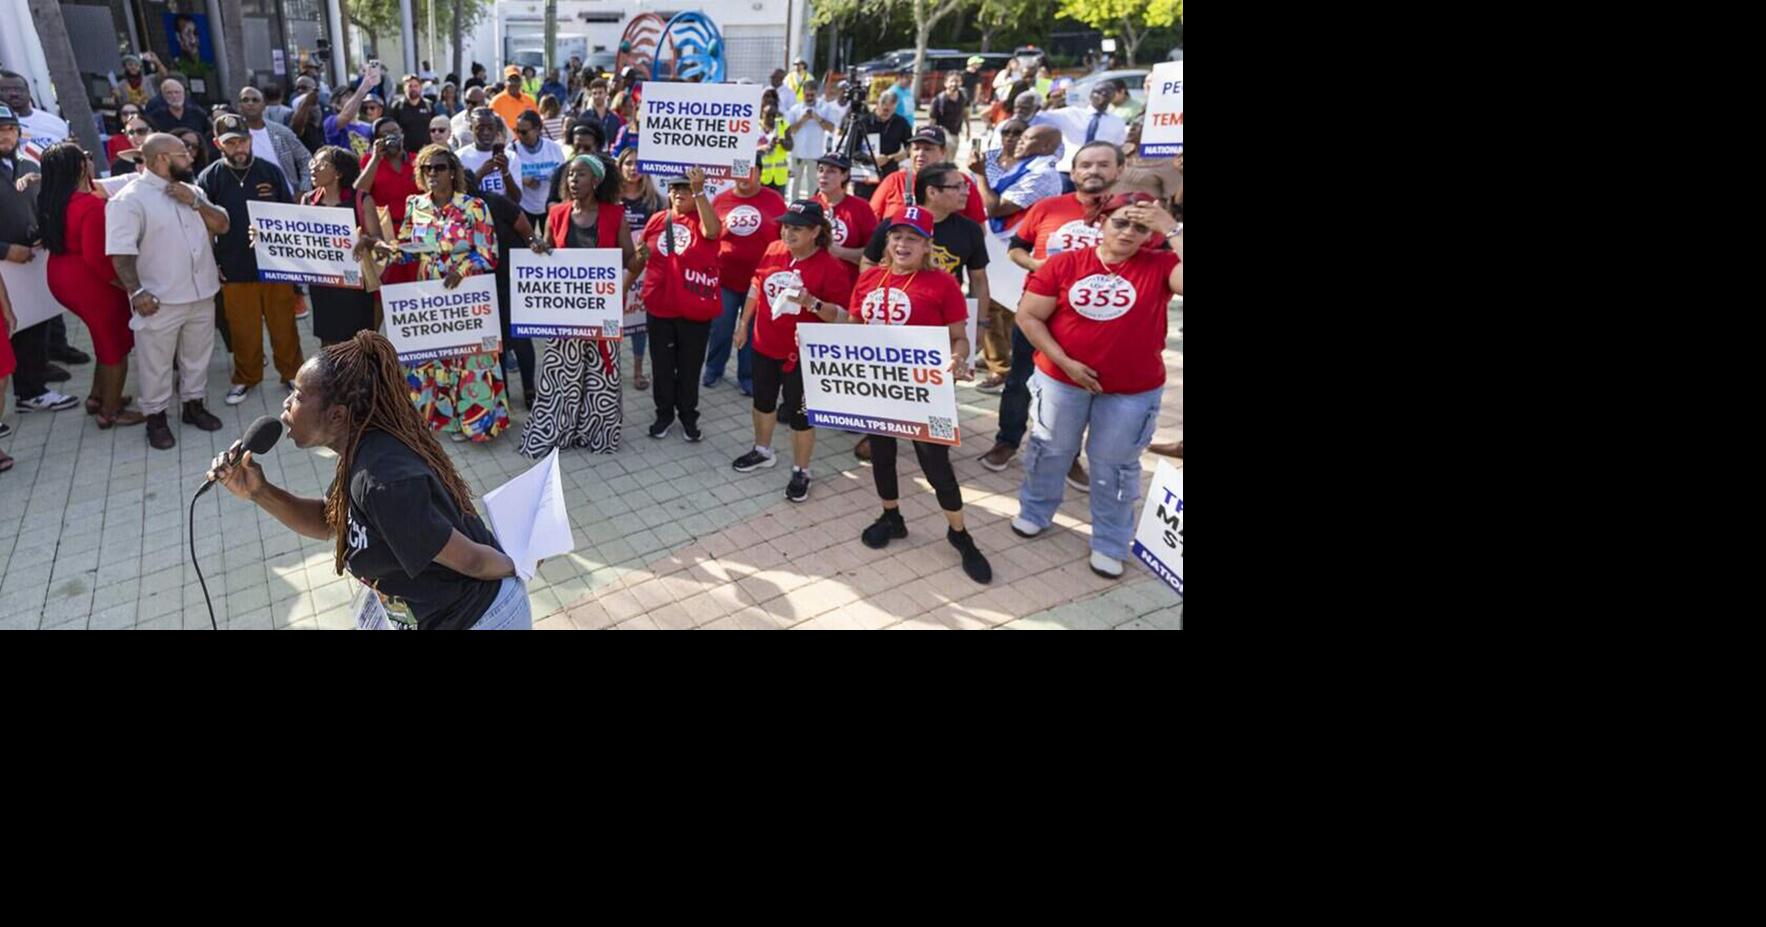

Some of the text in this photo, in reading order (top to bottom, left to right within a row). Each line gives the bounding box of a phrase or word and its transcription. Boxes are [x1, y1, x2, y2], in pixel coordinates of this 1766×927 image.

[1162, 81, 1183, 94] PE
[647, 101, 753, 117] TPS HOLDERS
[647, 117, 751, 133] MAKE THE US
[652, 132, 738, 149] STRONGER
[642, 163, 684, 173] NATIONAL
[256, 217, 351, 236] TPS HOLDERS
[730, 215, 758, 228] 355
[260, 232, 352, 249] MAKE THE US
[268, 245, 344, 262] STRONGER
[265, 272, 340, 284] NATIONAL TPS RALLY
[516, 266, 616, 279] TPS HOLDERS
[517, 281, 616, 295] MAKE THE US
[389, 291, 491, 313] TPS HOLDERS
[524, 296, 606, 310] STRONGER
[1074, 288, 1130, 307] 355
[392, 304, 492, 326] MAKE THE US
[401, 318, 483, 338] STRONGER
[516, 326, 598, 336] NATIONAL TPS RALLY
[398, 346, 478, 361] NATIONAL TPS RALLY
[806, 343, 942, 366] TPS HOLDERS
[810, 361, 944, 386] MAKE THE US
[821, 379, 930, 403] STRONGER
[814, 413, 921, 436] NATIONAL TPS RALLY
